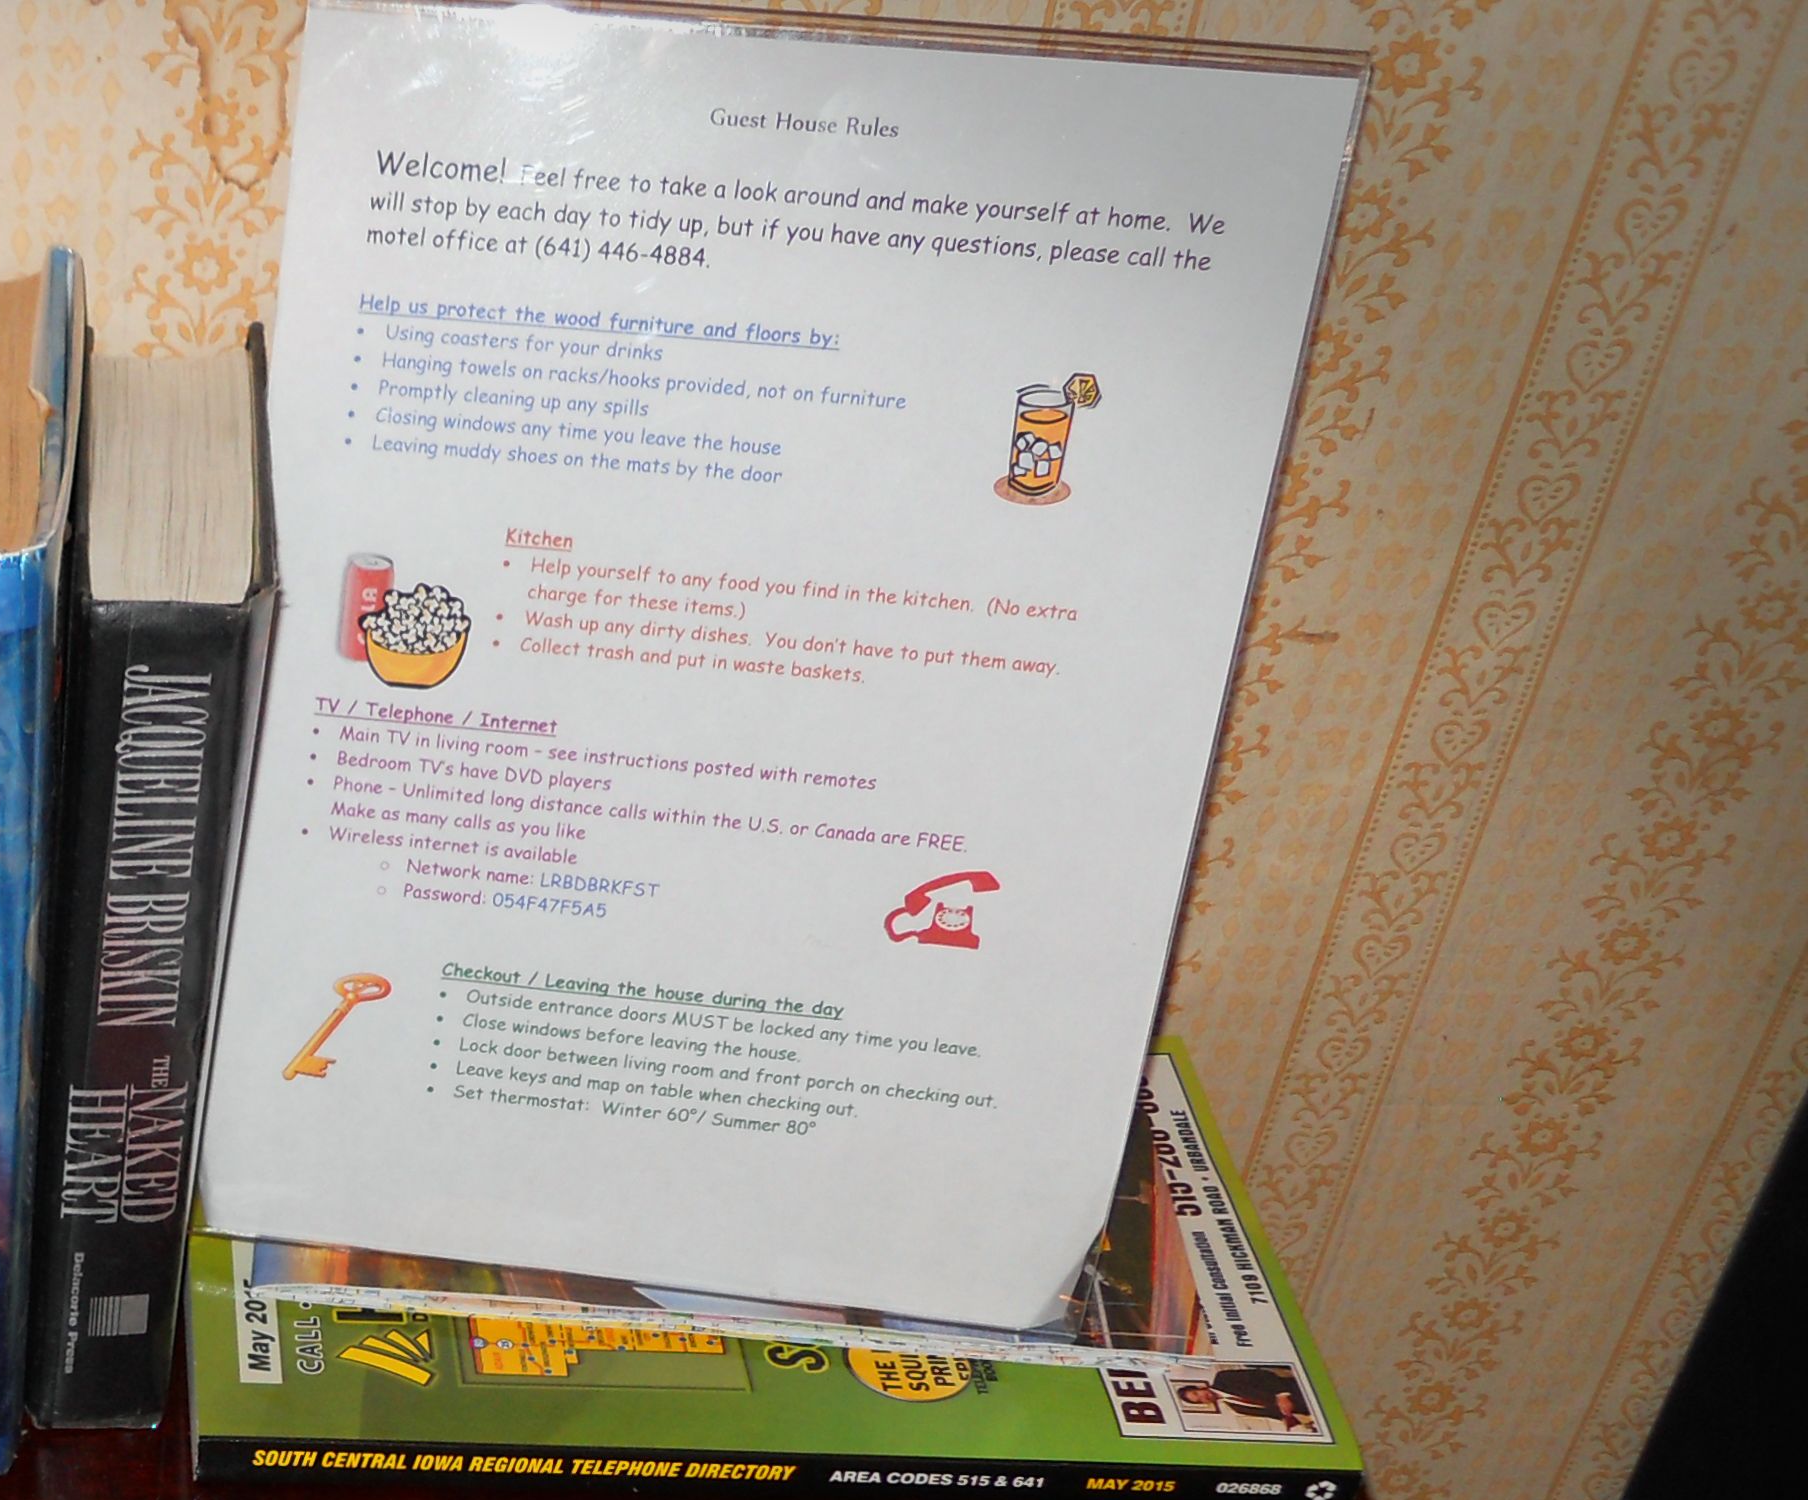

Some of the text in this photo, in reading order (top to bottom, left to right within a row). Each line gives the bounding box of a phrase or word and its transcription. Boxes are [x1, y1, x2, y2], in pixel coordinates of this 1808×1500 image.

[709, 106, 899, 138] Guest House Rules
[376, 150, 506, 184] Welcome!
[573, 167, 620, 192] free
[629, 173, 651, 193] to
[658, 174, 707, 198] take
[713, 183, 726, 199] a
[733, 177, 778, 202] look
[783, 186, 860, 208] around
[865, 190, 906, 211] and
[911, 193, 968, 216] make
[974, 200, 1070, 224] yourself
[1074, 206, 1101, 226] at
[1106, 205, 1170, 232] home.
[1188, 211, 1225, 235] We
[365, 225, 710, 269] motel office at (641) 446-4884.
[358, 292, 842, 350] Help us protect the wood furniture and floors by:
[505, 527, 573, 551] Kitchen
[315, 696, 560, 734] TV Telephone Internet
[97, 664, 211, 1029] JACQUELINE BRISKIN
[405, 857, 660, 897] Network name: LRBDBRKFST
[402, 882, 607, 918] Password: 054F47F5A5
[151, 1055, 171, 1088] THE
[452, 1083, 484, 1100] Set
[489, 1087, 589, 1111] thermostat:
[601, 1099, 662, 1119] Winter
[710, 1111, 781, 1132] Summer
[60, 1084, 130, 1225] HEART
[121, 1081, 188, 1224] NAKED
[248, 1330, 275, 1371] May
[297, 1316, 323, 1375] CALL
[874, 1359, 902, 1391] THE
[251, 1448, 797, 1480] SOUTH CENTRAL IOWA REGIONAL TELEPHONE DIRECTORY
[828, 1469, 1045, 1488] AREA CODES 515 & 641
[1085, 1477, 1176, 1492] MAY 2015
[1215, 1481, 1282, 1495] 026868
